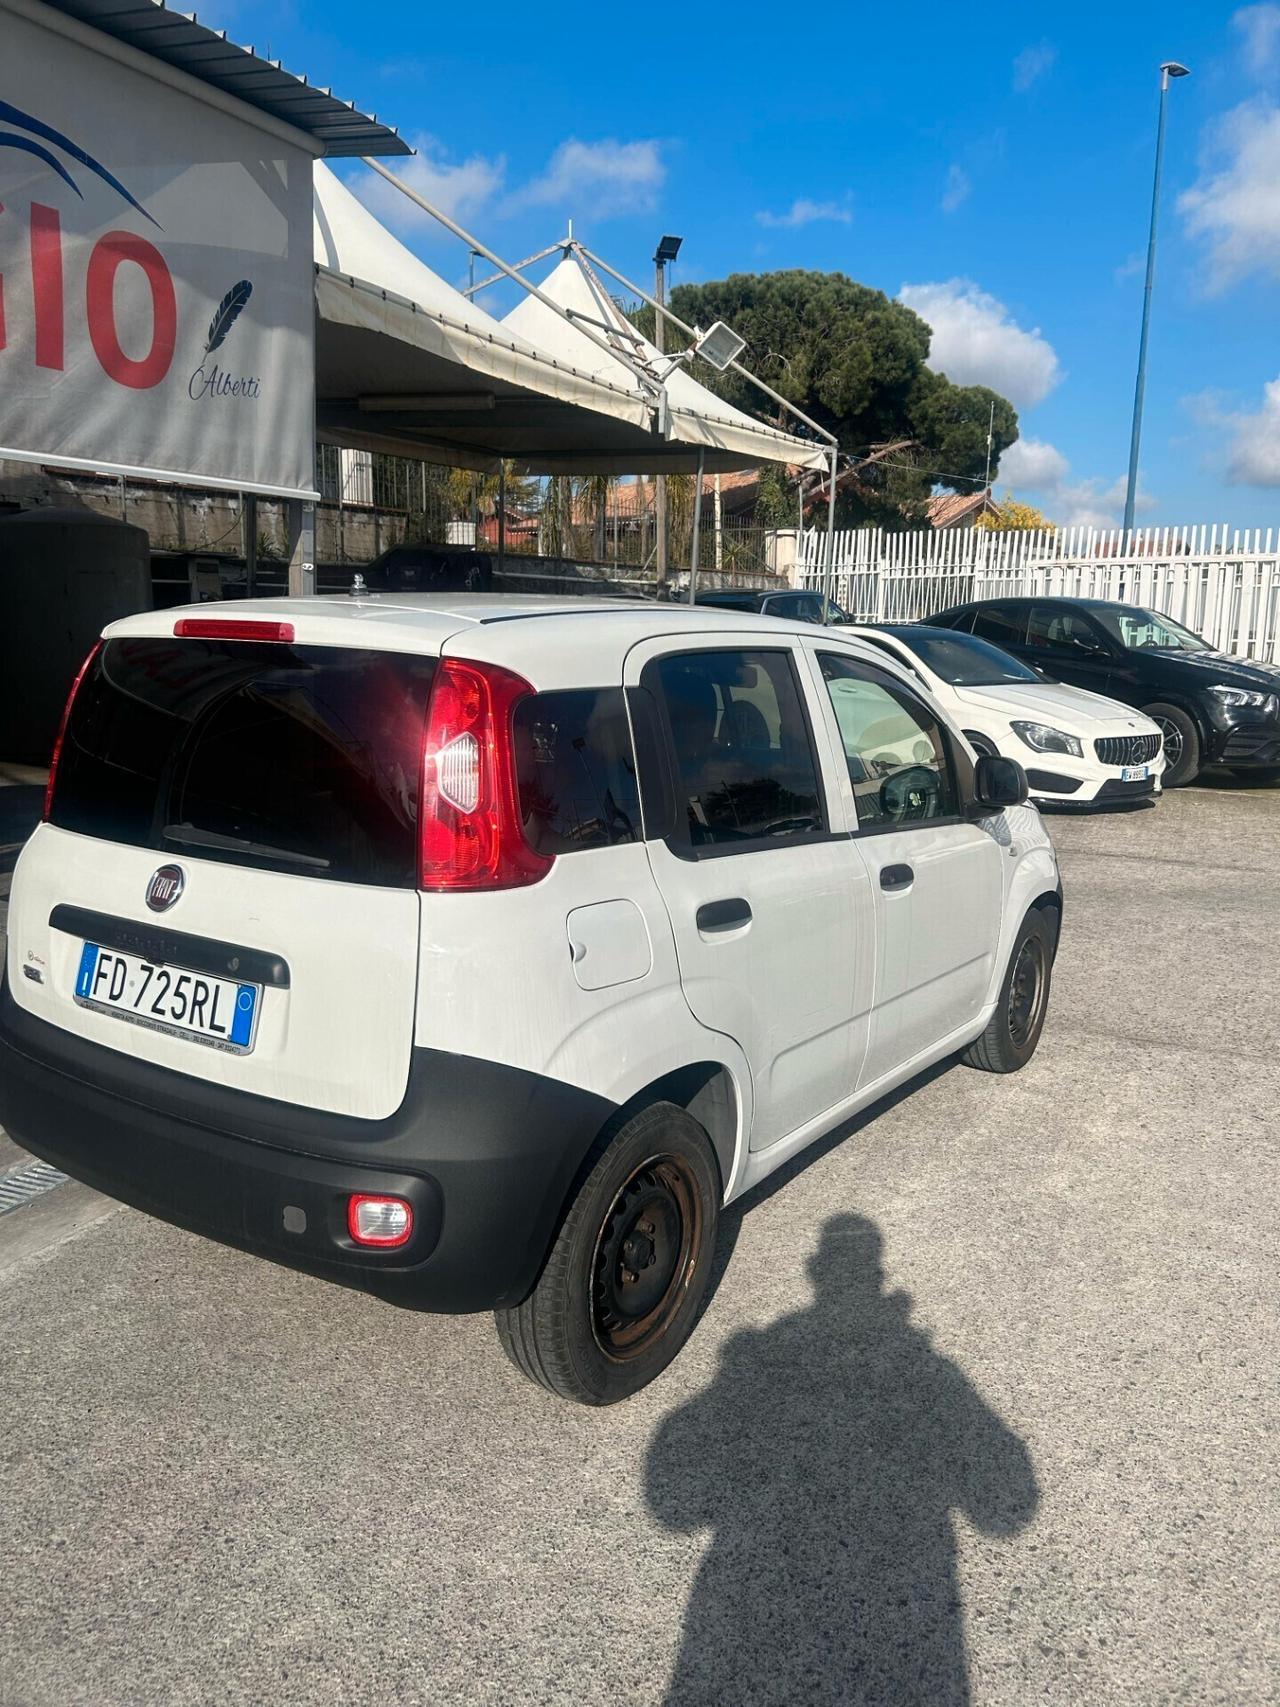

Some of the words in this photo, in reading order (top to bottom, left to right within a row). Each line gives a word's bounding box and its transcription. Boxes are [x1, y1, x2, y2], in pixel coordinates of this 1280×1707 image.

[0, 202, 177, 390] IO
[189, 365, 261, 400] Alberti
[152, 876, 177, 899] FIAT
[93, 953, 128, 1002] FD
[133, 964, 226, 1034] 725RL
